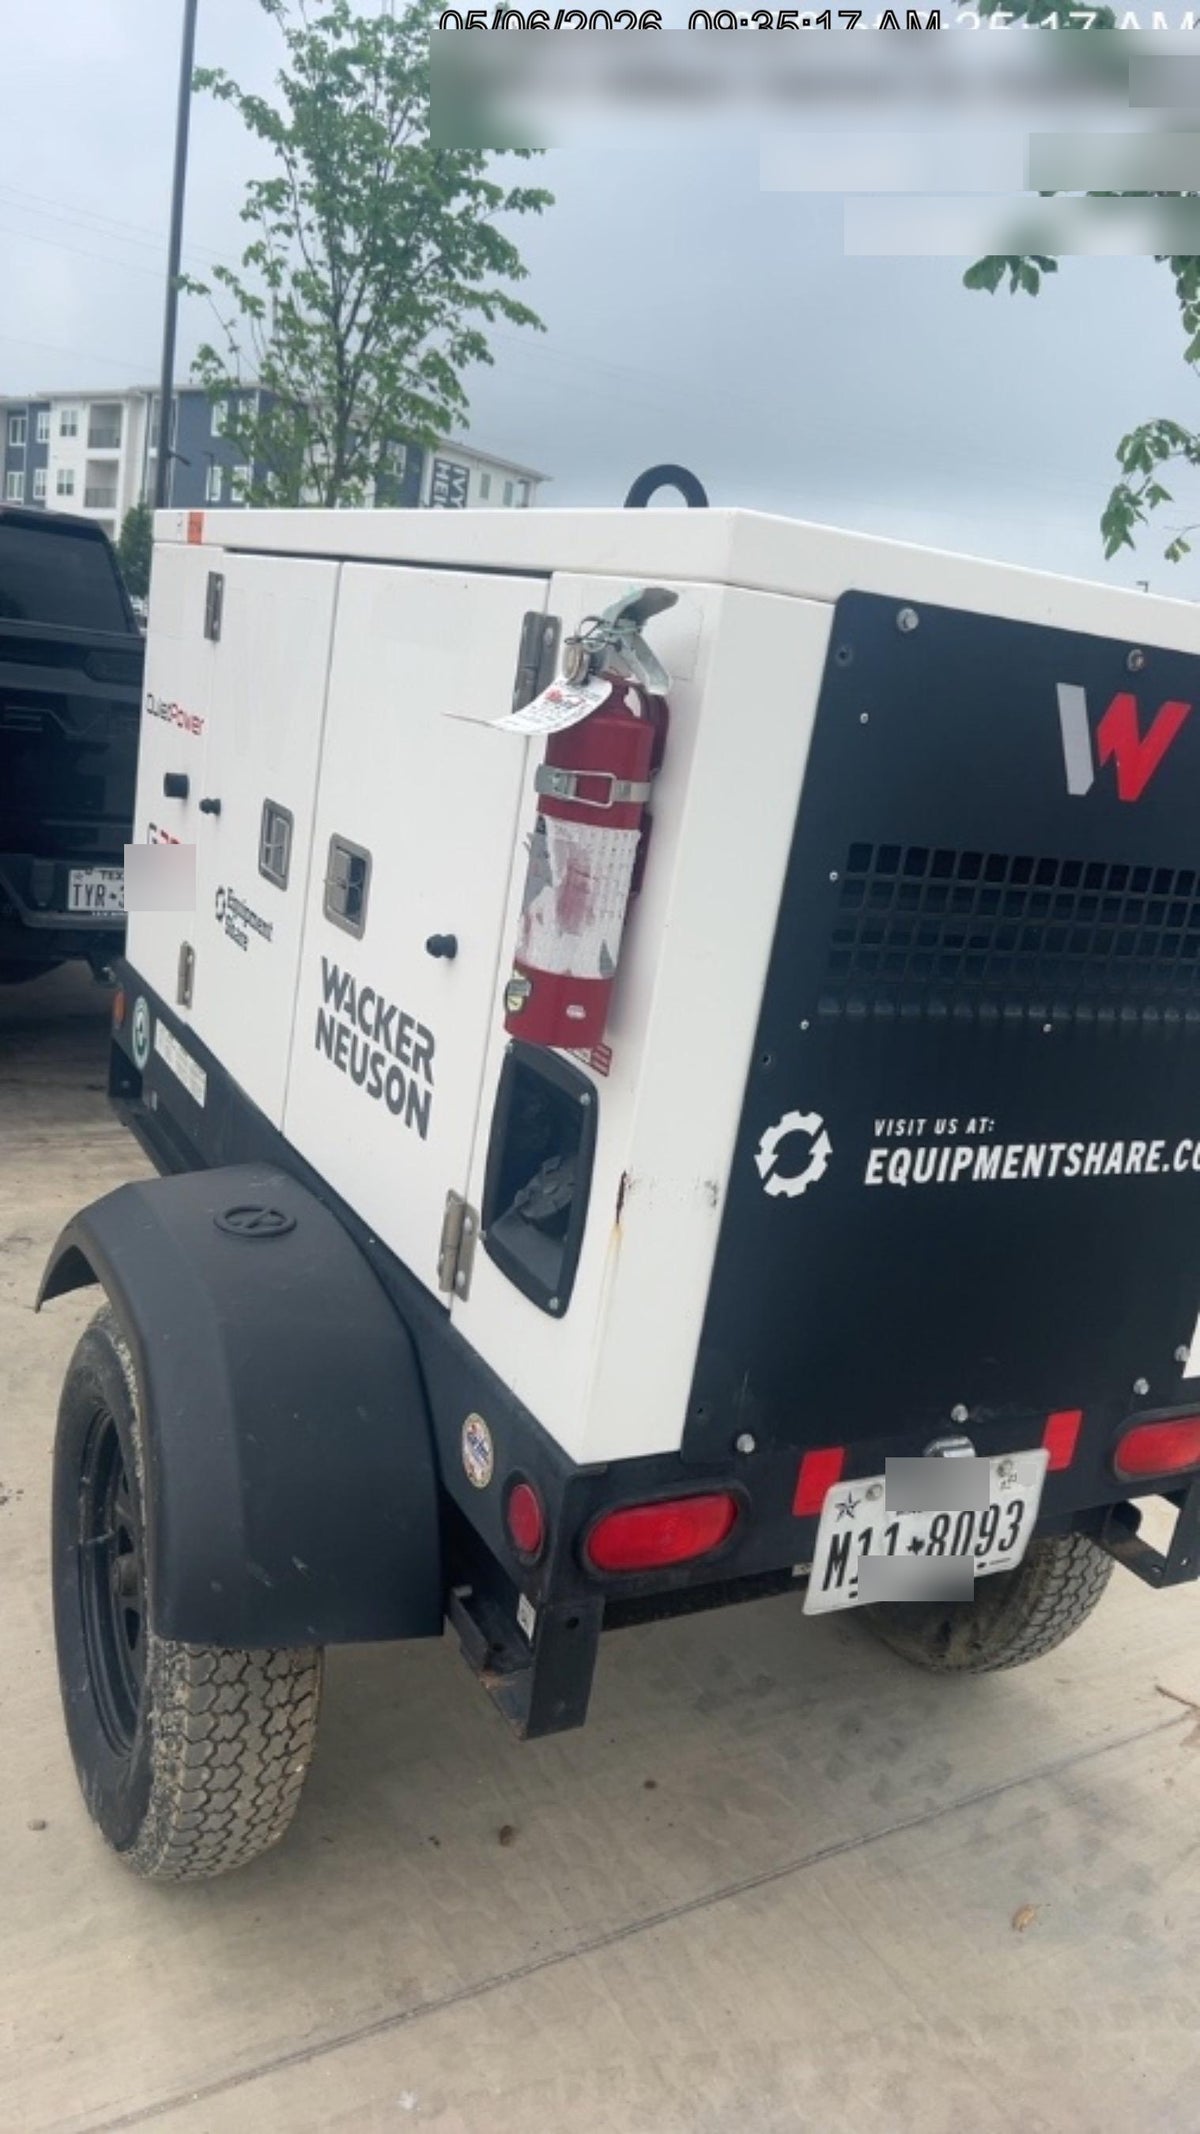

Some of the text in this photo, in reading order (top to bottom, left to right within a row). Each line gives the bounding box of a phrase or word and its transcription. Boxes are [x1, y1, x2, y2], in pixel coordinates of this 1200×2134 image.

[433, 461, 450, 508] HEI
[73, 884, 105, 907] TYR
[227, 887, 273, 942] Equipment
[321, 955, 435, 1086] WACKER
[315, 1006, 432, 1141] NEUSON
[874, 1116, 995, 1137] VISIT US AT:
